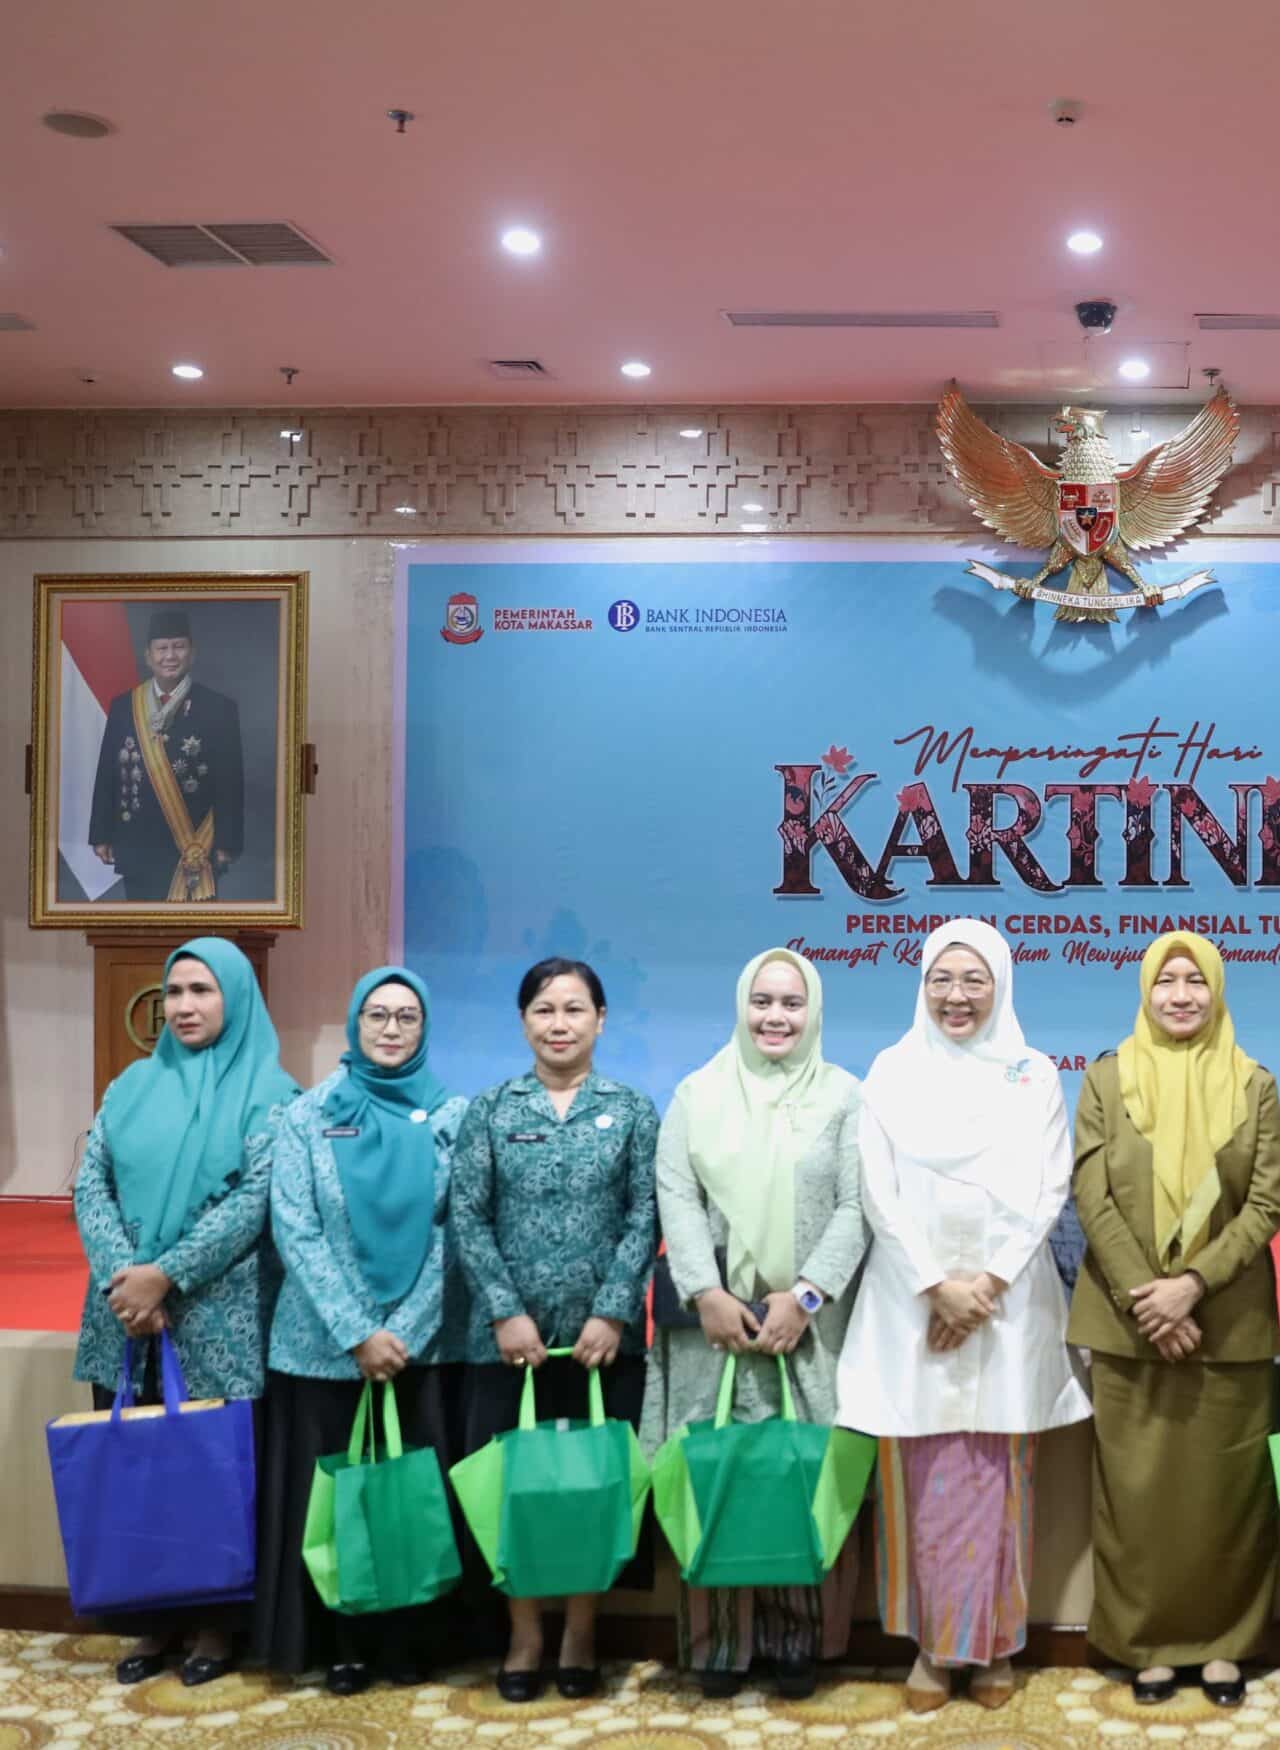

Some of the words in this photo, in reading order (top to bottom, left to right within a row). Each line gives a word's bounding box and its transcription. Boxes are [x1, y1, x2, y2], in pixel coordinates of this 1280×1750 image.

[494, 609, 575, 620] PEMERINTAH
[646, 608, 689, 623] BANK
[695, 608, 787, 623] INDONESIA
[494, 619, 525, 630] KOTA
[528, 619, 593, 630] MAKASSAR
[1176, 721, 1263, 785] Hari
[846, 914, 997, 934] PEREMPN
[1005, 914, 1111, 938] CERDAS,
[1119, 915, 1252, 935] FINANSIAL
